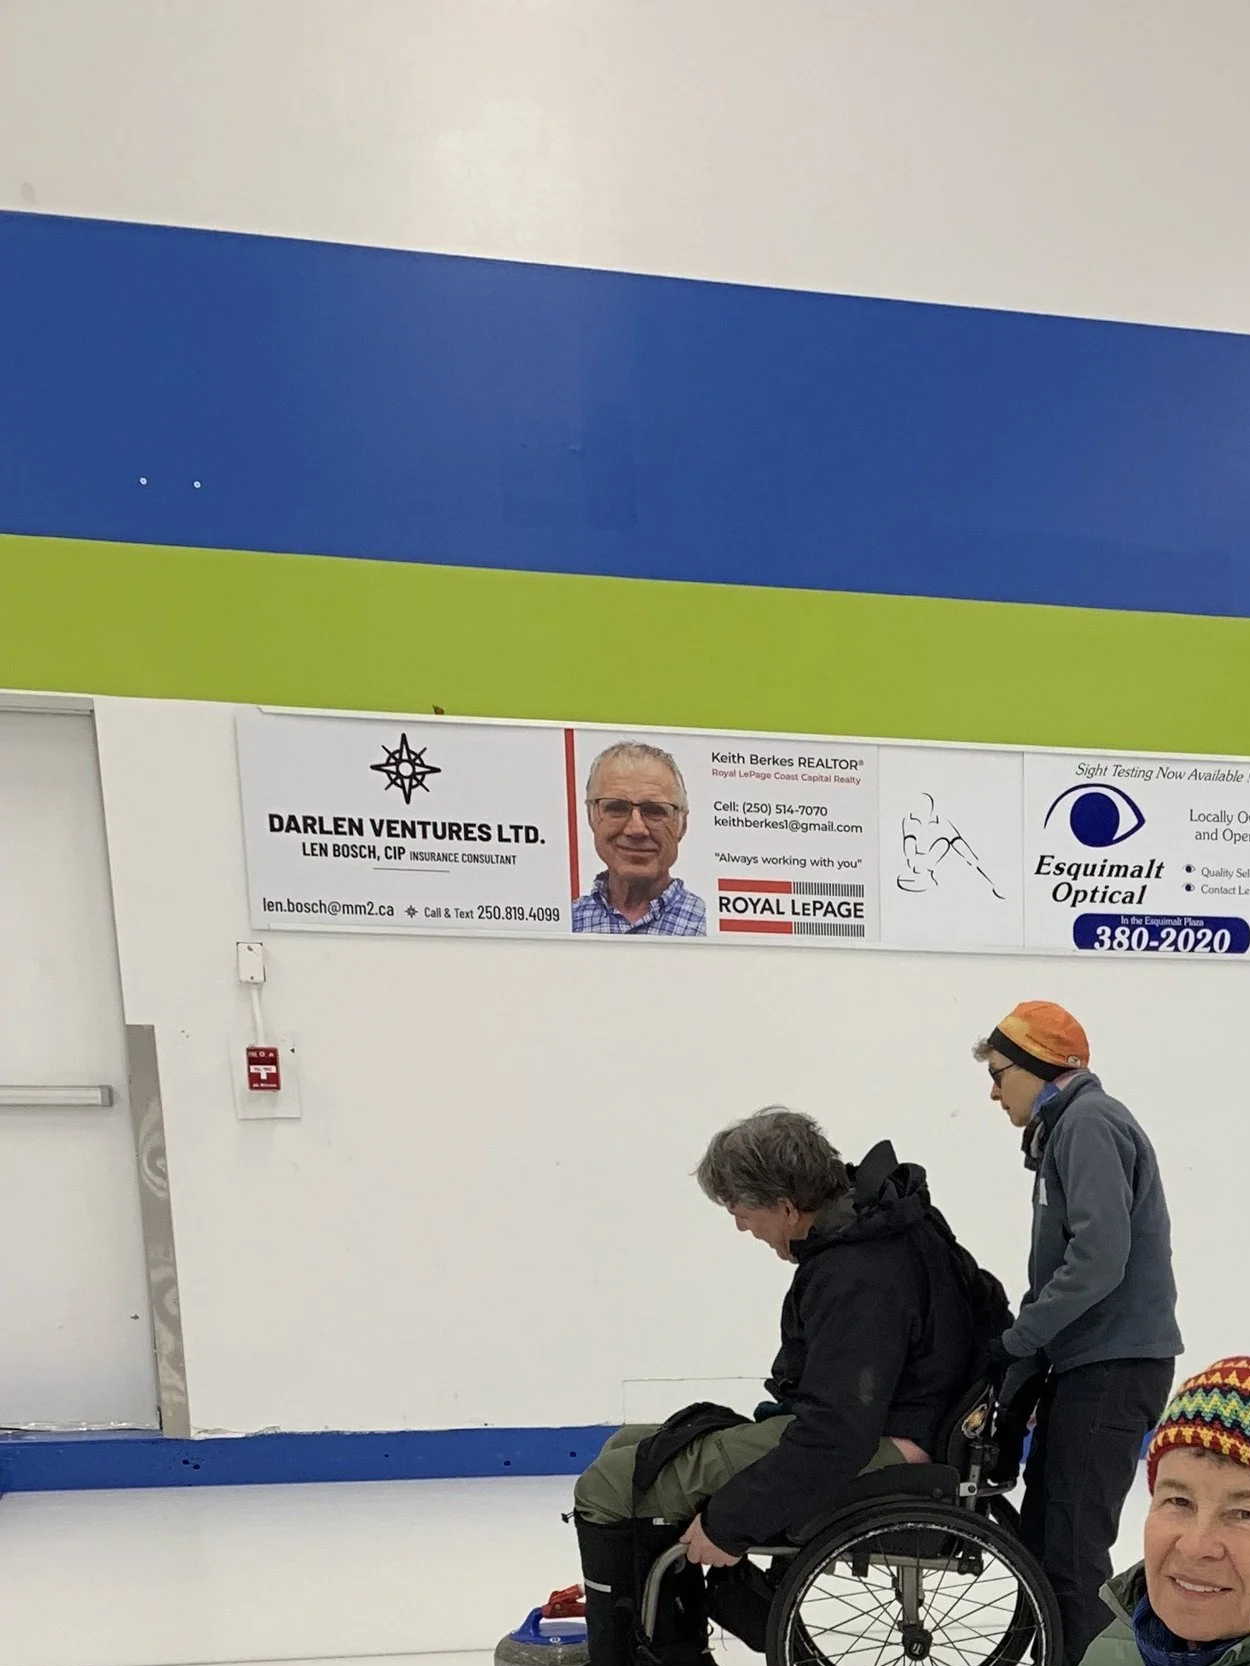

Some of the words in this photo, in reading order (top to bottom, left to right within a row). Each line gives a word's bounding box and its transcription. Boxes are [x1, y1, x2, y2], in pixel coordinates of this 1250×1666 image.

[711, 751, 746, 765] Keith
[749, 753, 795, 768] Berkes
[711, 768, 737, 779] Royal
[738, 769, 772, 781] LePage
[773, 771, 799, 781] Coast
[800, 773, 832, 783] Capital
[833, 774, 862, 786] Realty
[1075, 762, 1109, 779] Sight
[1112, 764, 1154, 782] Testing
[1155, 766, 1187, 780] Now
[1187, 768, 1244, 783] Available
[713, 800, 739, 813] Cell:
[742, 801, 772, 816] (250)
[775, 803, 828, 817] 514-7070
[1189, 808, 1234, 826] Locally
[268, 813, 364, 837] DARLEN
[369, 818, 492, 843] VENTURES
[497, 824, 546, 845] LTD.
[714, 815, 863, 834] keithberkes1@gmail.com
[1194, 827, 1219, 841] and
[301, 841, 329, 858] LEN
[332, 843, 381, 862] BOSCH,
[384, 845, 406, 861] CIP
[409, 851, 460, 863] INSURANCE
[461, 852, 517, 865] CONSULTANT
[760, 855, 807, 869] working
[809, 857, 835, 868] with
[1034, 854, 1165, 881] Esquimalt
[1200, 866, 1235, 880] Quality
[1051, 881, 1148, 908] Optical
[1200, 883, 1237, 895] Contact
[262, 897, 395, 917] len.bosch@mm2.ca
[424, 906, 442, 918] Call
[443, 907, 452, 919] &
[454, 907, 474, 920] Text
[477, 904, 560, 922] 250.819.4099
[718, 895, 786, 916] ROYAL
[1144, 915, 1183, 928] Esquimalt
[1183, 917, 1205, 927] Plaza
[1094, 926, 1231, 953] 380-2020
